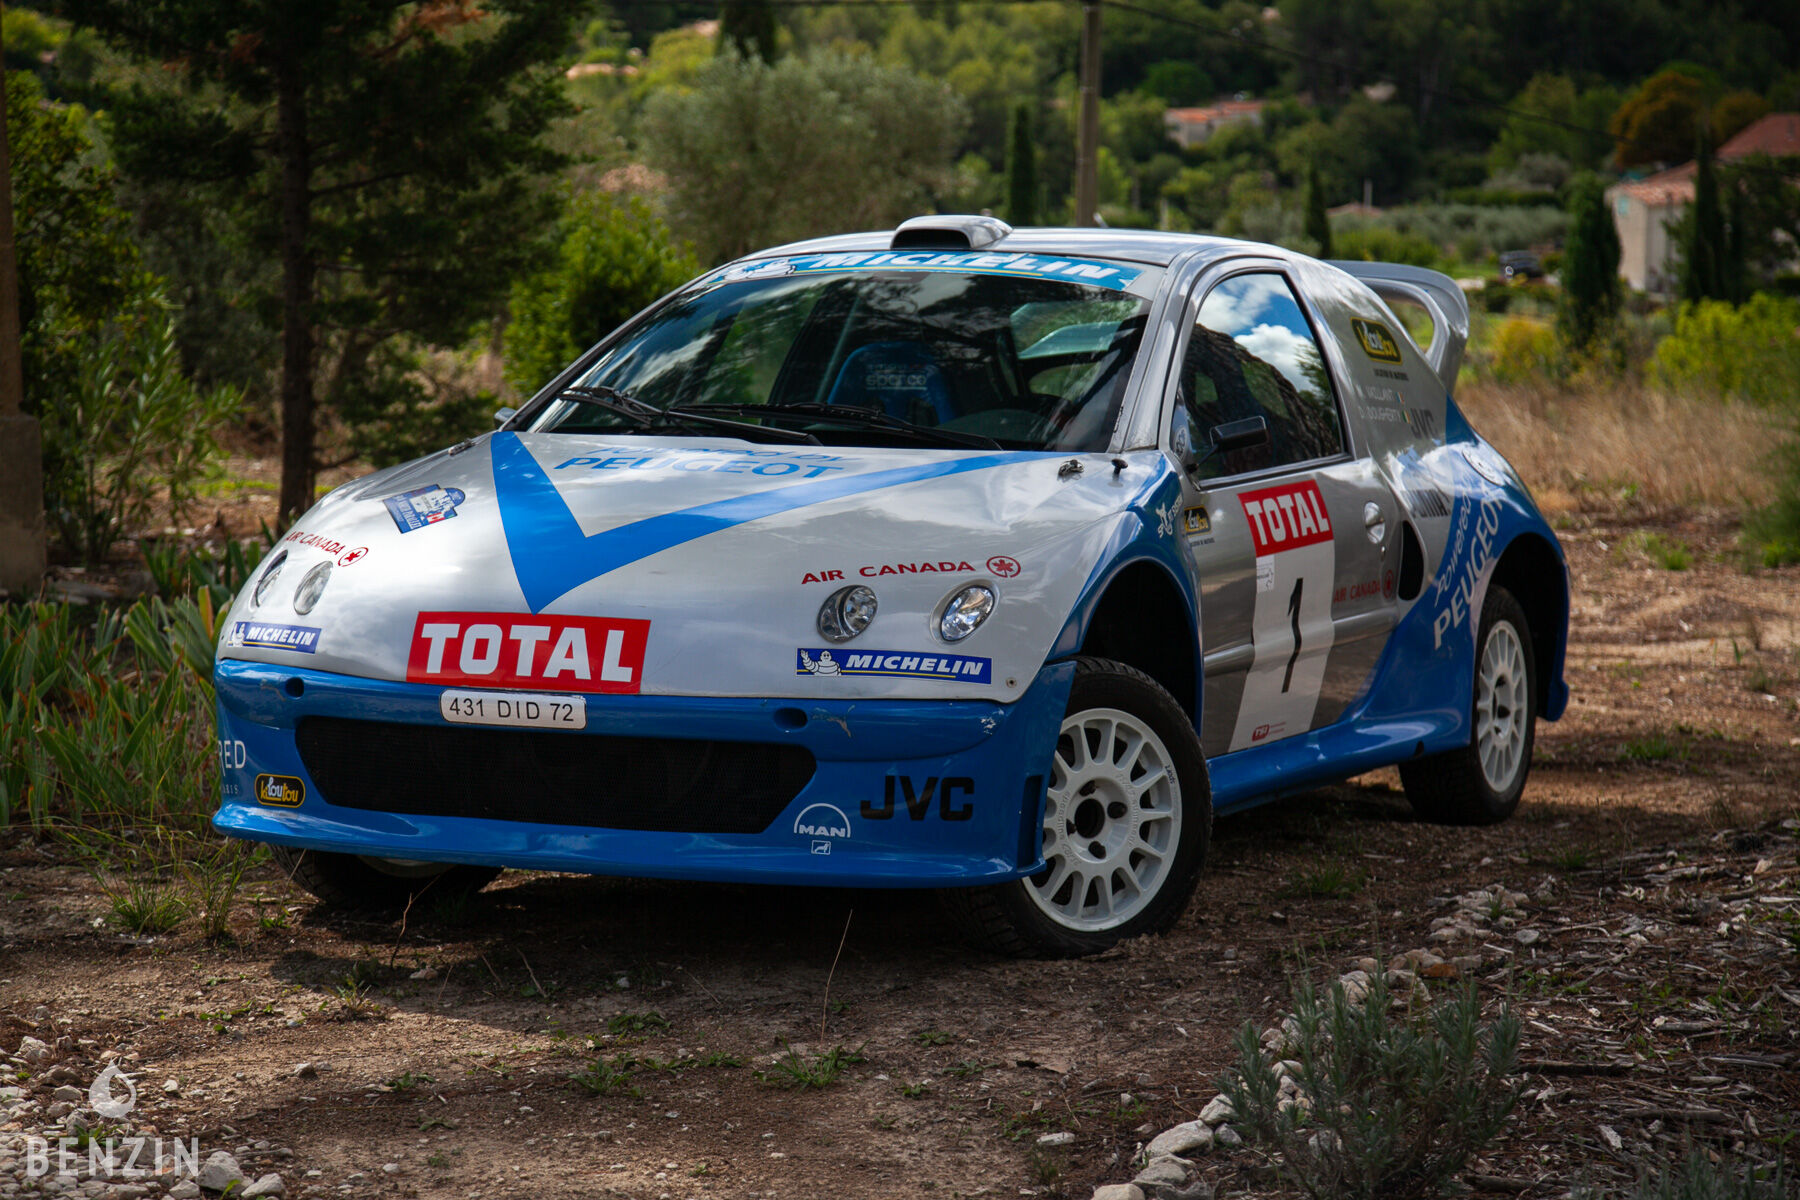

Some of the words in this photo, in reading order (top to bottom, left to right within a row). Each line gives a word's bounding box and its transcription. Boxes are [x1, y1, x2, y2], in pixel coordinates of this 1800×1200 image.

[809, 253, 1120, 279] MICHELIN
[1410, 407, 1438, 439] JVC
[553, 456, 844, 478] PEUGEOT
[1244, 489, 1330, 546] TOTAL
[299, 534, 346, 556] CANADA
[801, 569, 846, 585] AIR
[859, 560, 976, 577] CANADA
[1433, 479, 1503, 650] PEUGEOT
[246, 627, 316, 646] MICHELIN
[1281, 577, 1304, 694] 1
[421, 623, 634, 682] TOTAL
[846, 654, 984, 676] MICHELIN
[450, 698, 484, 717] 431
[497, 700, 540, 720] DID
[550, 703, 574, 721] 72
[860, 775, 975, 822] JVC
[799, 824, 846, 838] MAN
